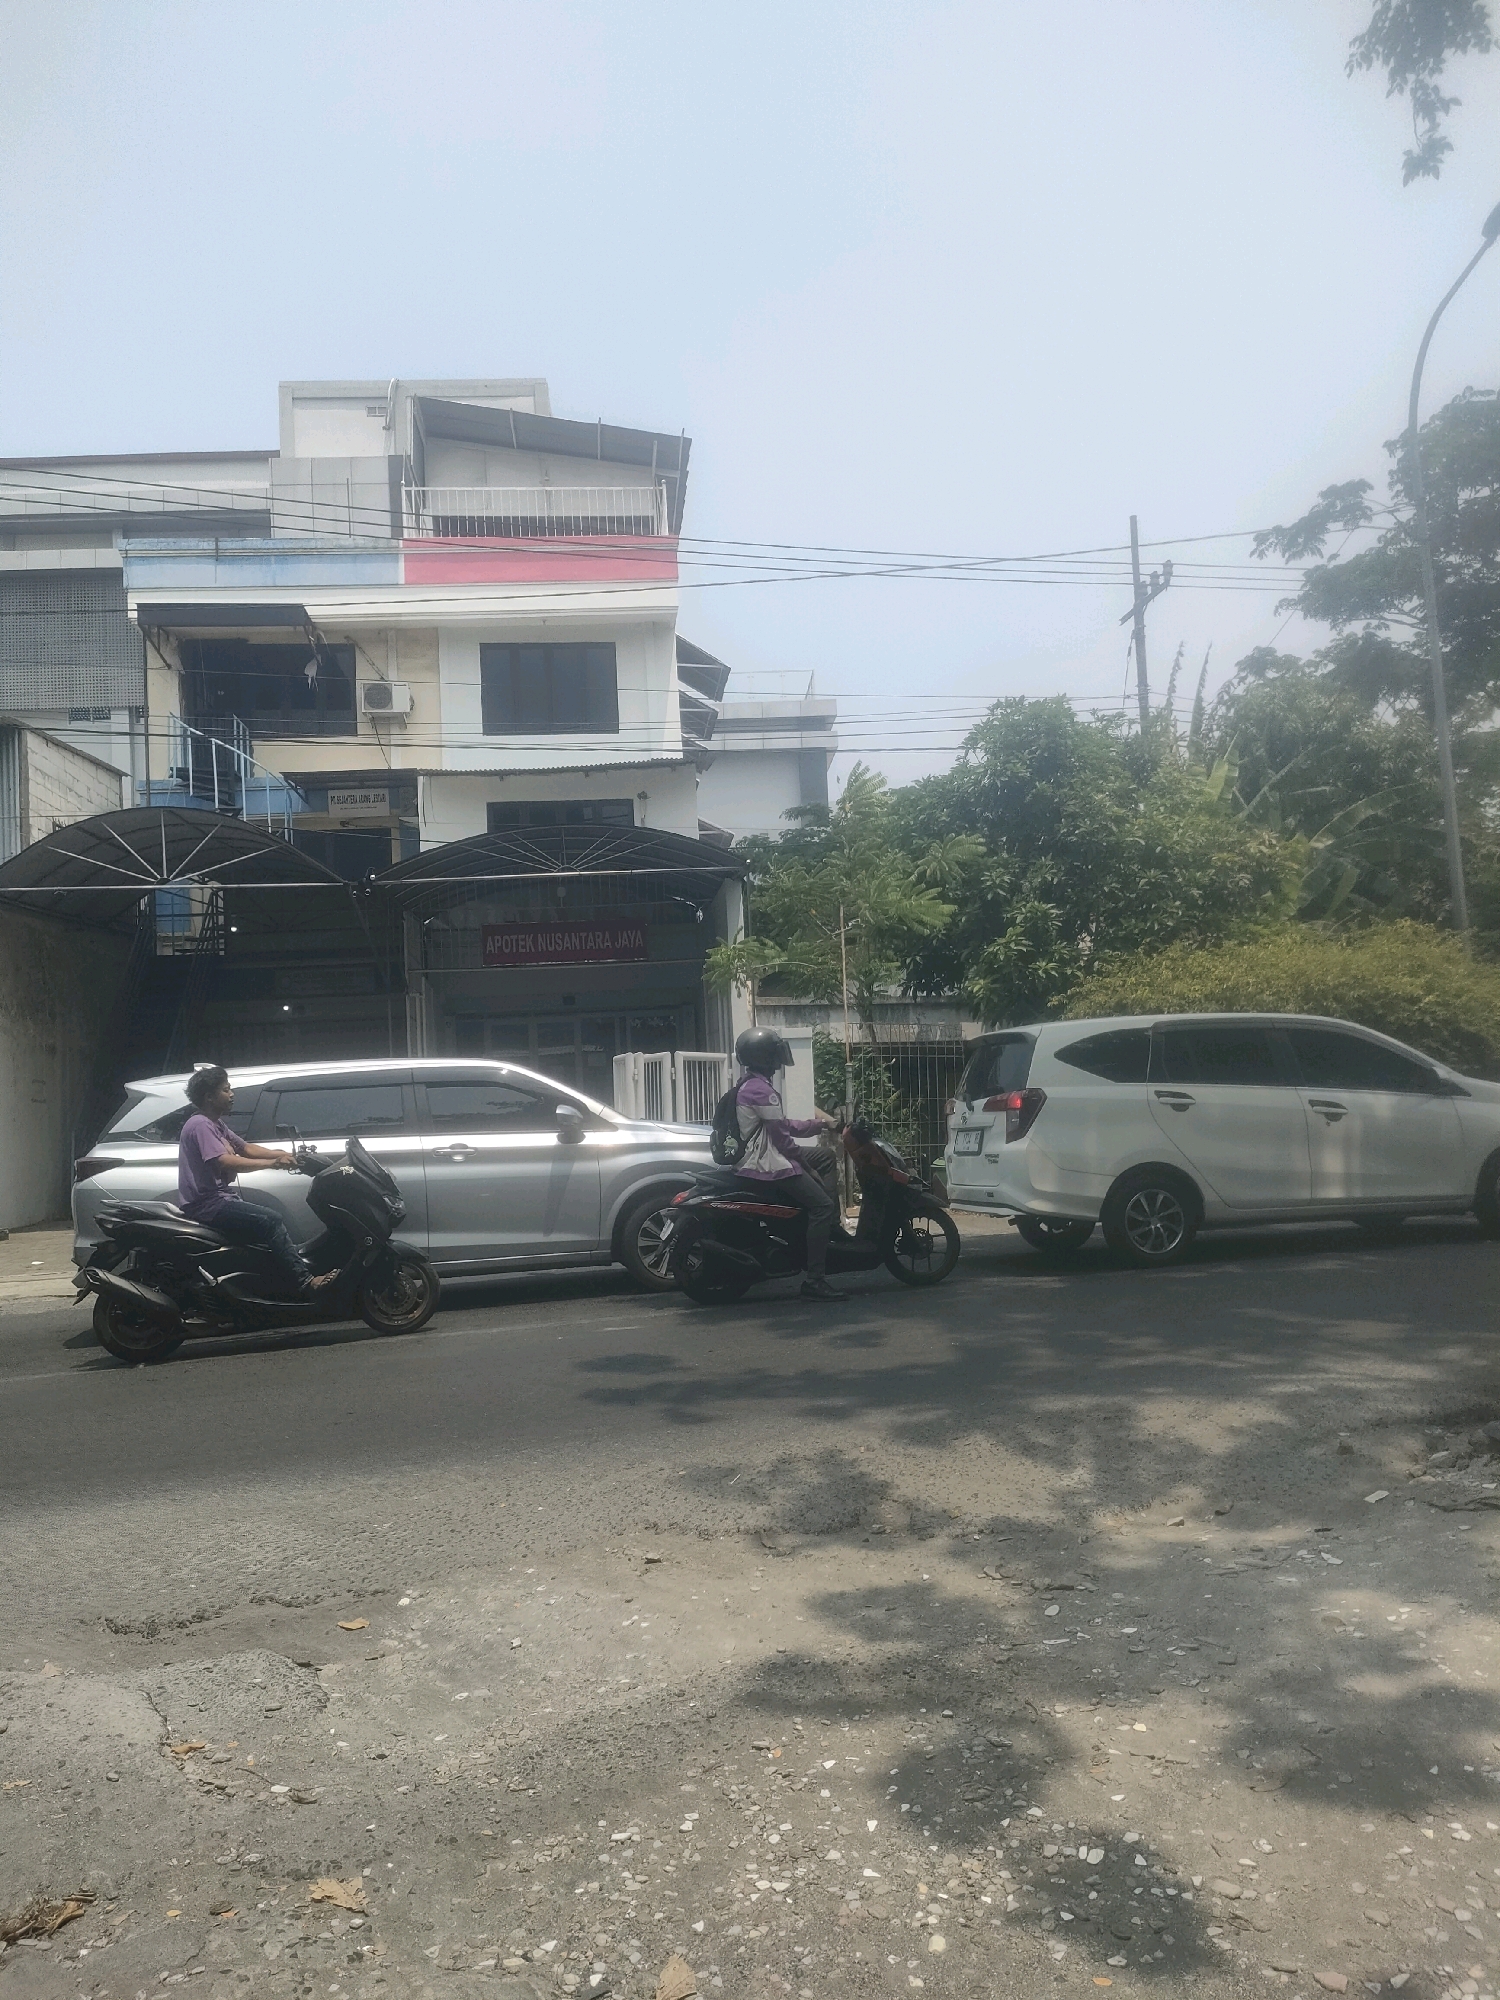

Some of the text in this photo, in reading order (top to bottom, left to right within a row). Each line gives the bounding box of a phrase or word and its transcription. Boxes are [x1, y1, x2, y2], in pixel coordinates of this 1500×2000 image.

[486, 930, 644, 954] APOTEK NUSANTARA JAYA
